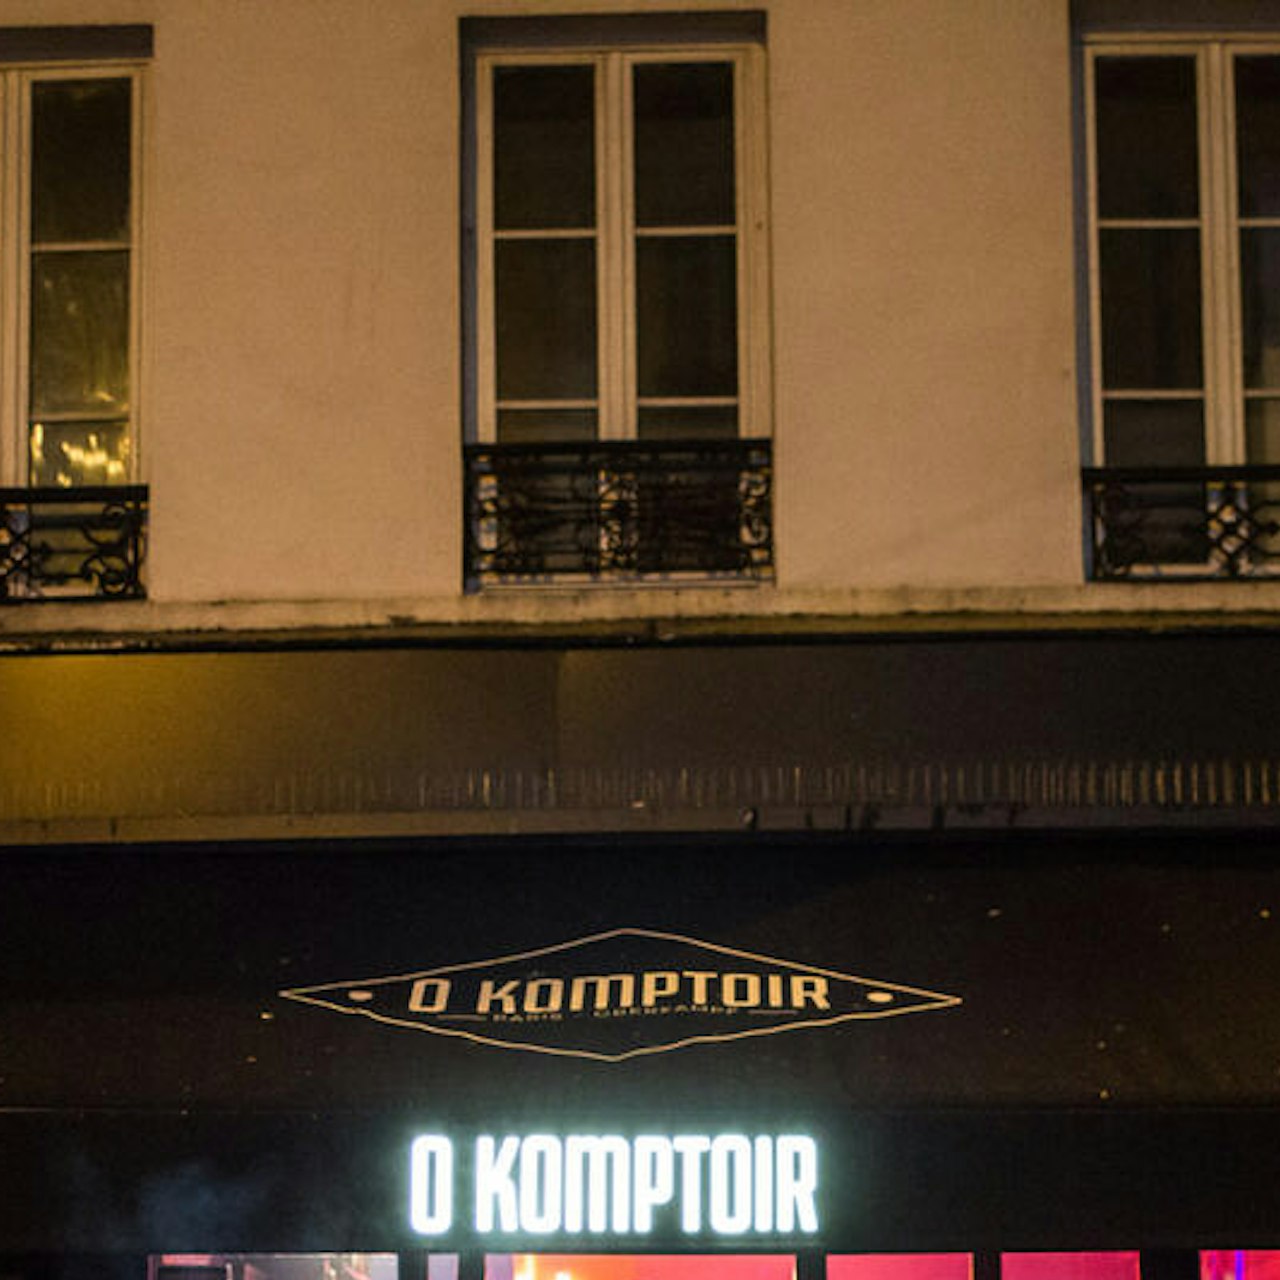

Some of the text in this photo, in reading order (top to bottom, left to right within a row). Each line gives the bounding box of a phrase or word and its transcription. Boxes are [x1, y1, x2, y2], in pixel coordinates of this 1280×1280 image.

[407, 970, 832, 1016] O KOMPTOIR
[410, 1133, 820, 1235] O KOMPTOIR
